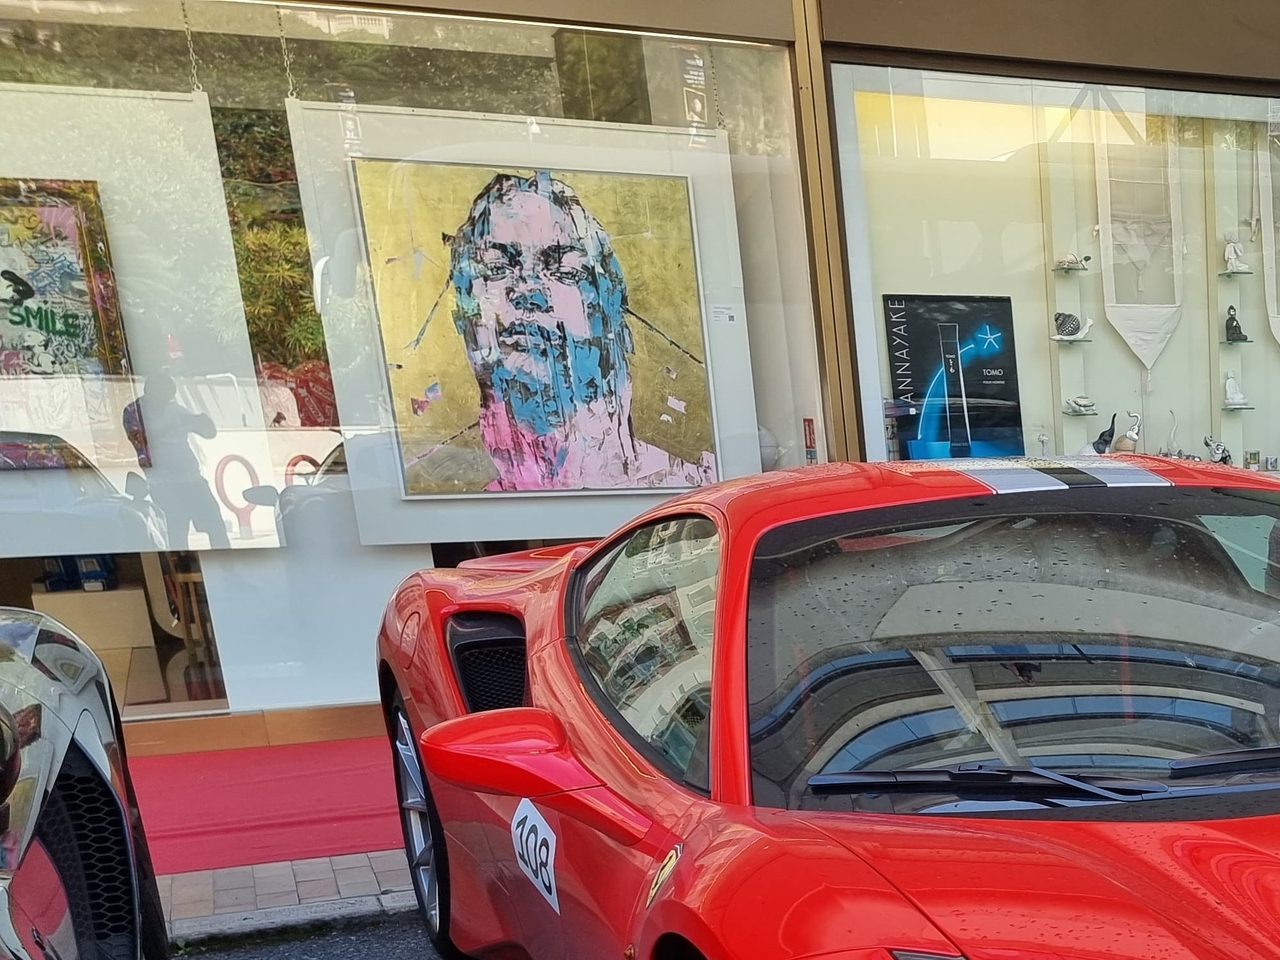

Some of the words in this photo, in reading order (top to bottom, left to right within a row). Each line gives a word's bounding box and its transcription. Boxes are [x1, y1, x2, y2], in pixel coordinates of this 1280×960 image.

[8, 305, 80, 338] SMILE
[889, 300, 915, 404] ANNAYAKE
[982, 368, 1004, 376] TOMO
[515, 814, 552, 896] 108
